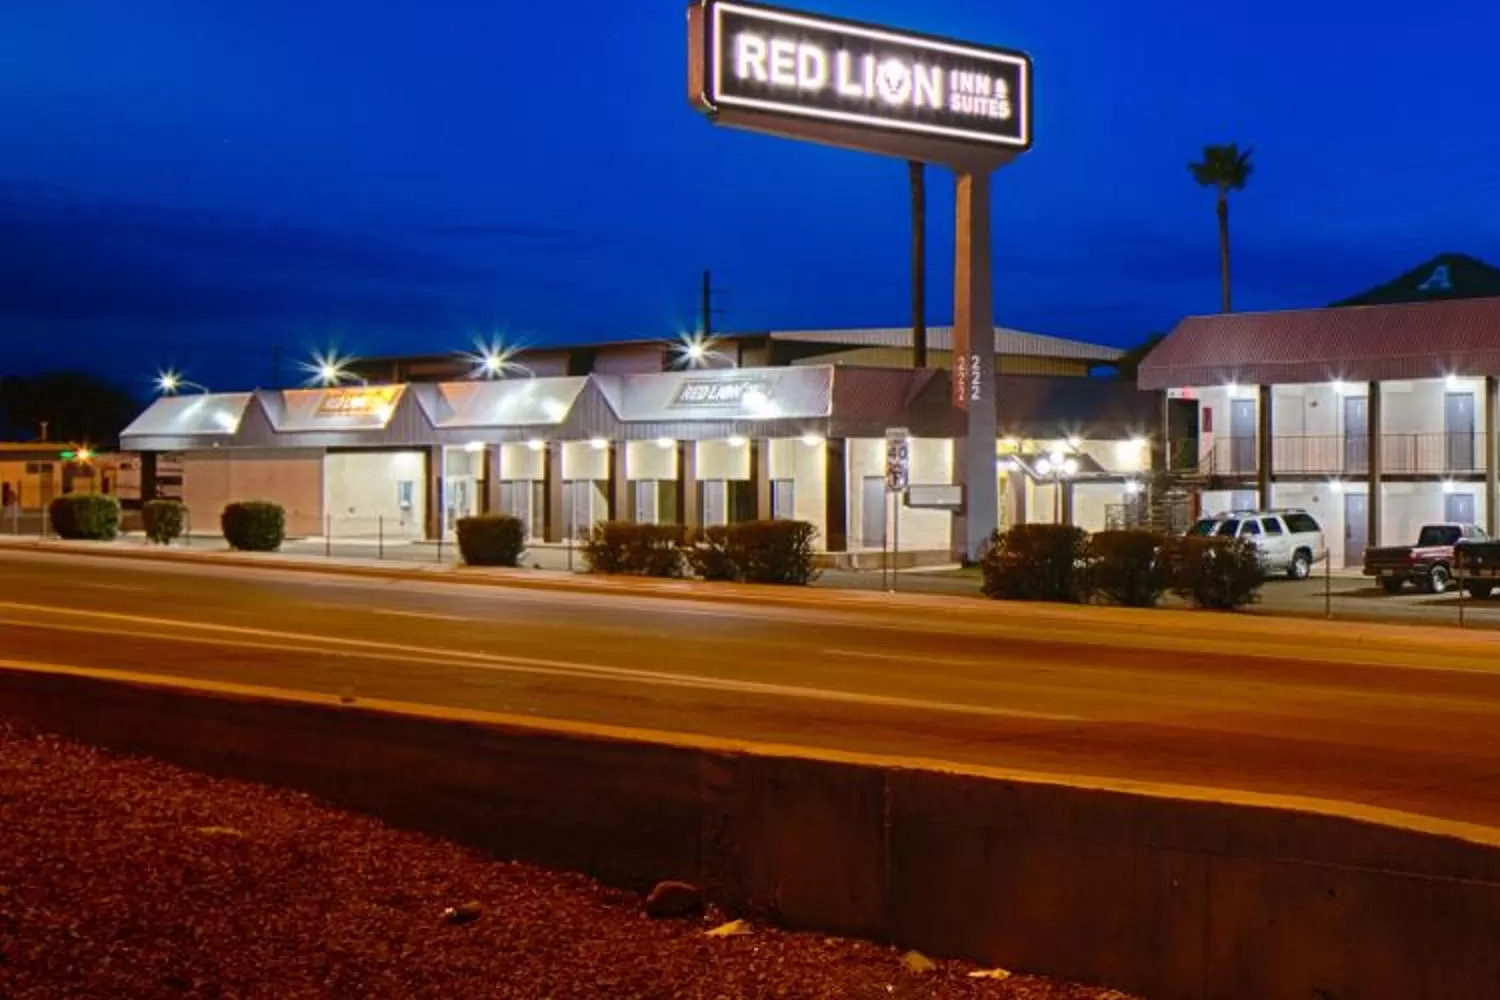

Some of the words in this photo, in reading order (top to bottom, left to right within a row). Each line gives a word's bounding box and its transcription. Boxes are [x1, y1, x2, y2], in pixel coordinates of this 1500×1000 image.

[734, 32, 825, 88] RED
[836, 50, 944, 109] LION
[950, 69, 991, 96] INN
[950, 92, 1011, 119] SUITES
[971, 355, 982, 401] 222
